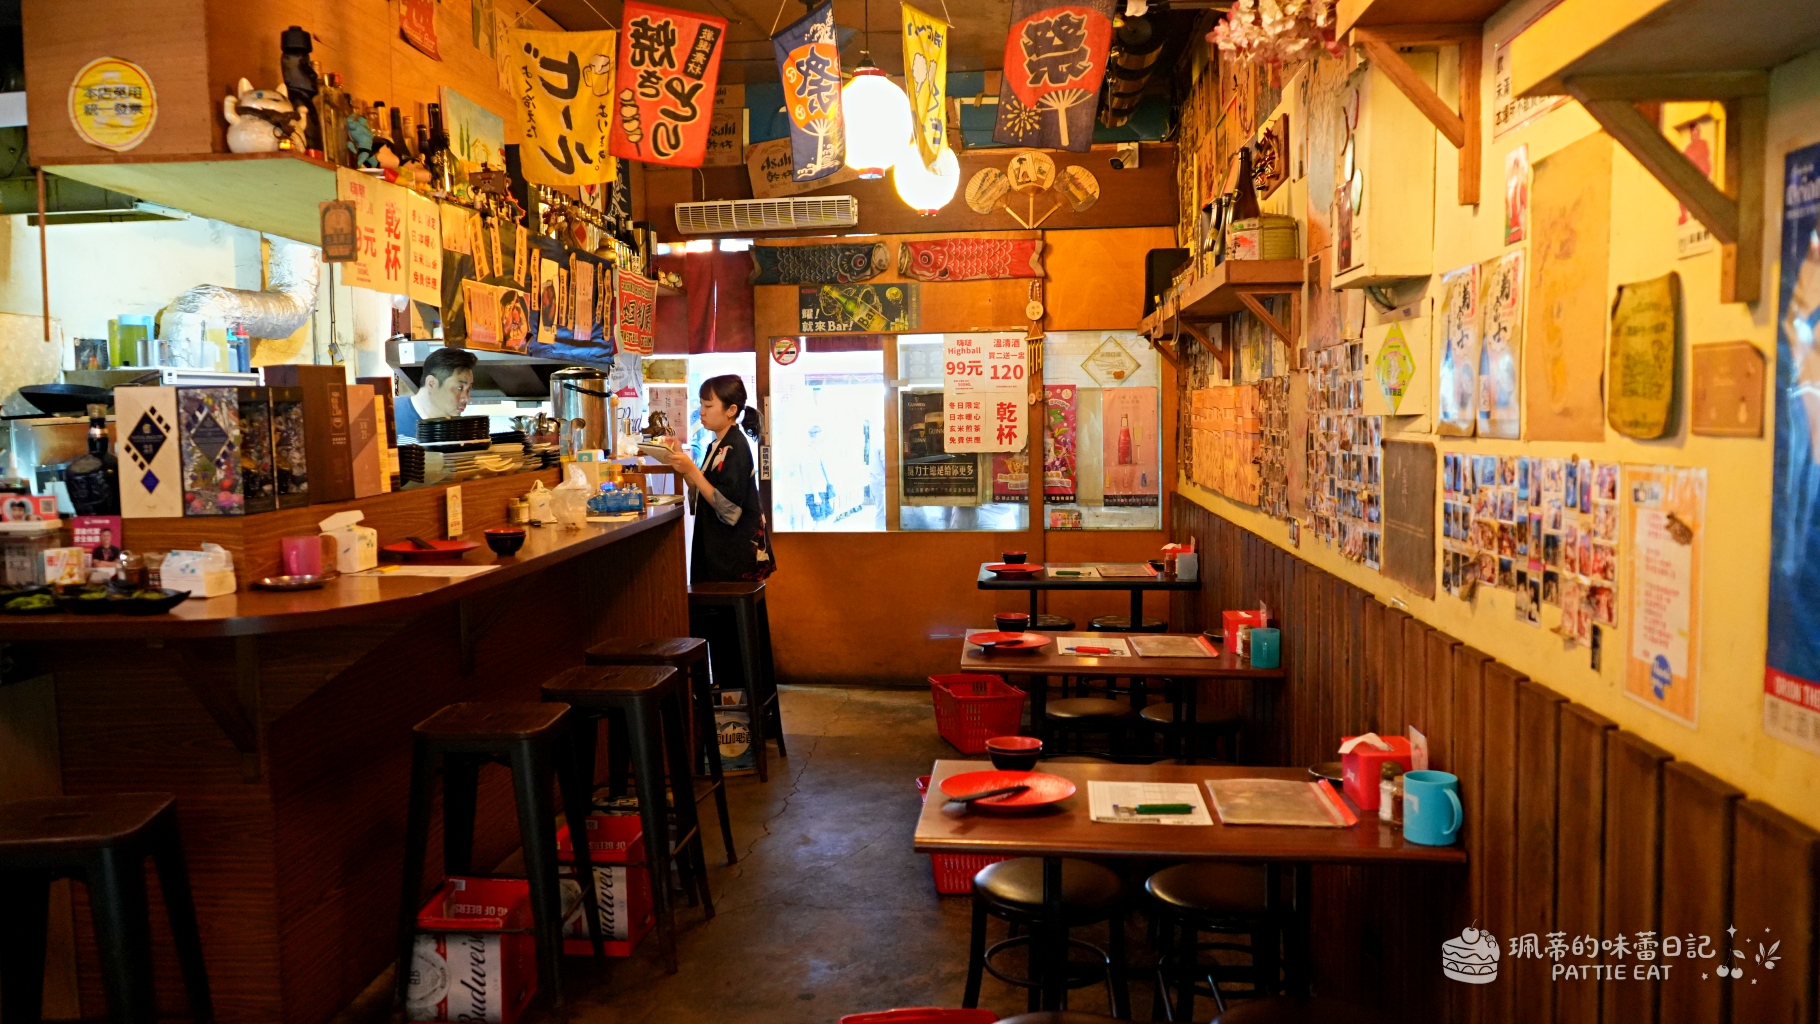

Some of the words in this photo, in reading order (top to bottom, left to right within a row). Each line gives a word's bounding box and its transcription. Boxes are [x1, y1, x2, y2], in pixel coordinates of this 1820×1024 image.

[947, 347, 982, 357] Highball
[945, 360, 983, 376] 99元
[990, 364, 1024, 380] 120
[949, 402, 981, 410] 冬日限定
[949, 413, 981, 421] 日本暖心
[949, 424, 982, 433] 玄米煎茶
[996, 402, 1018, 446] 乾杯
[949, 436, 982, 444] 免費供應
